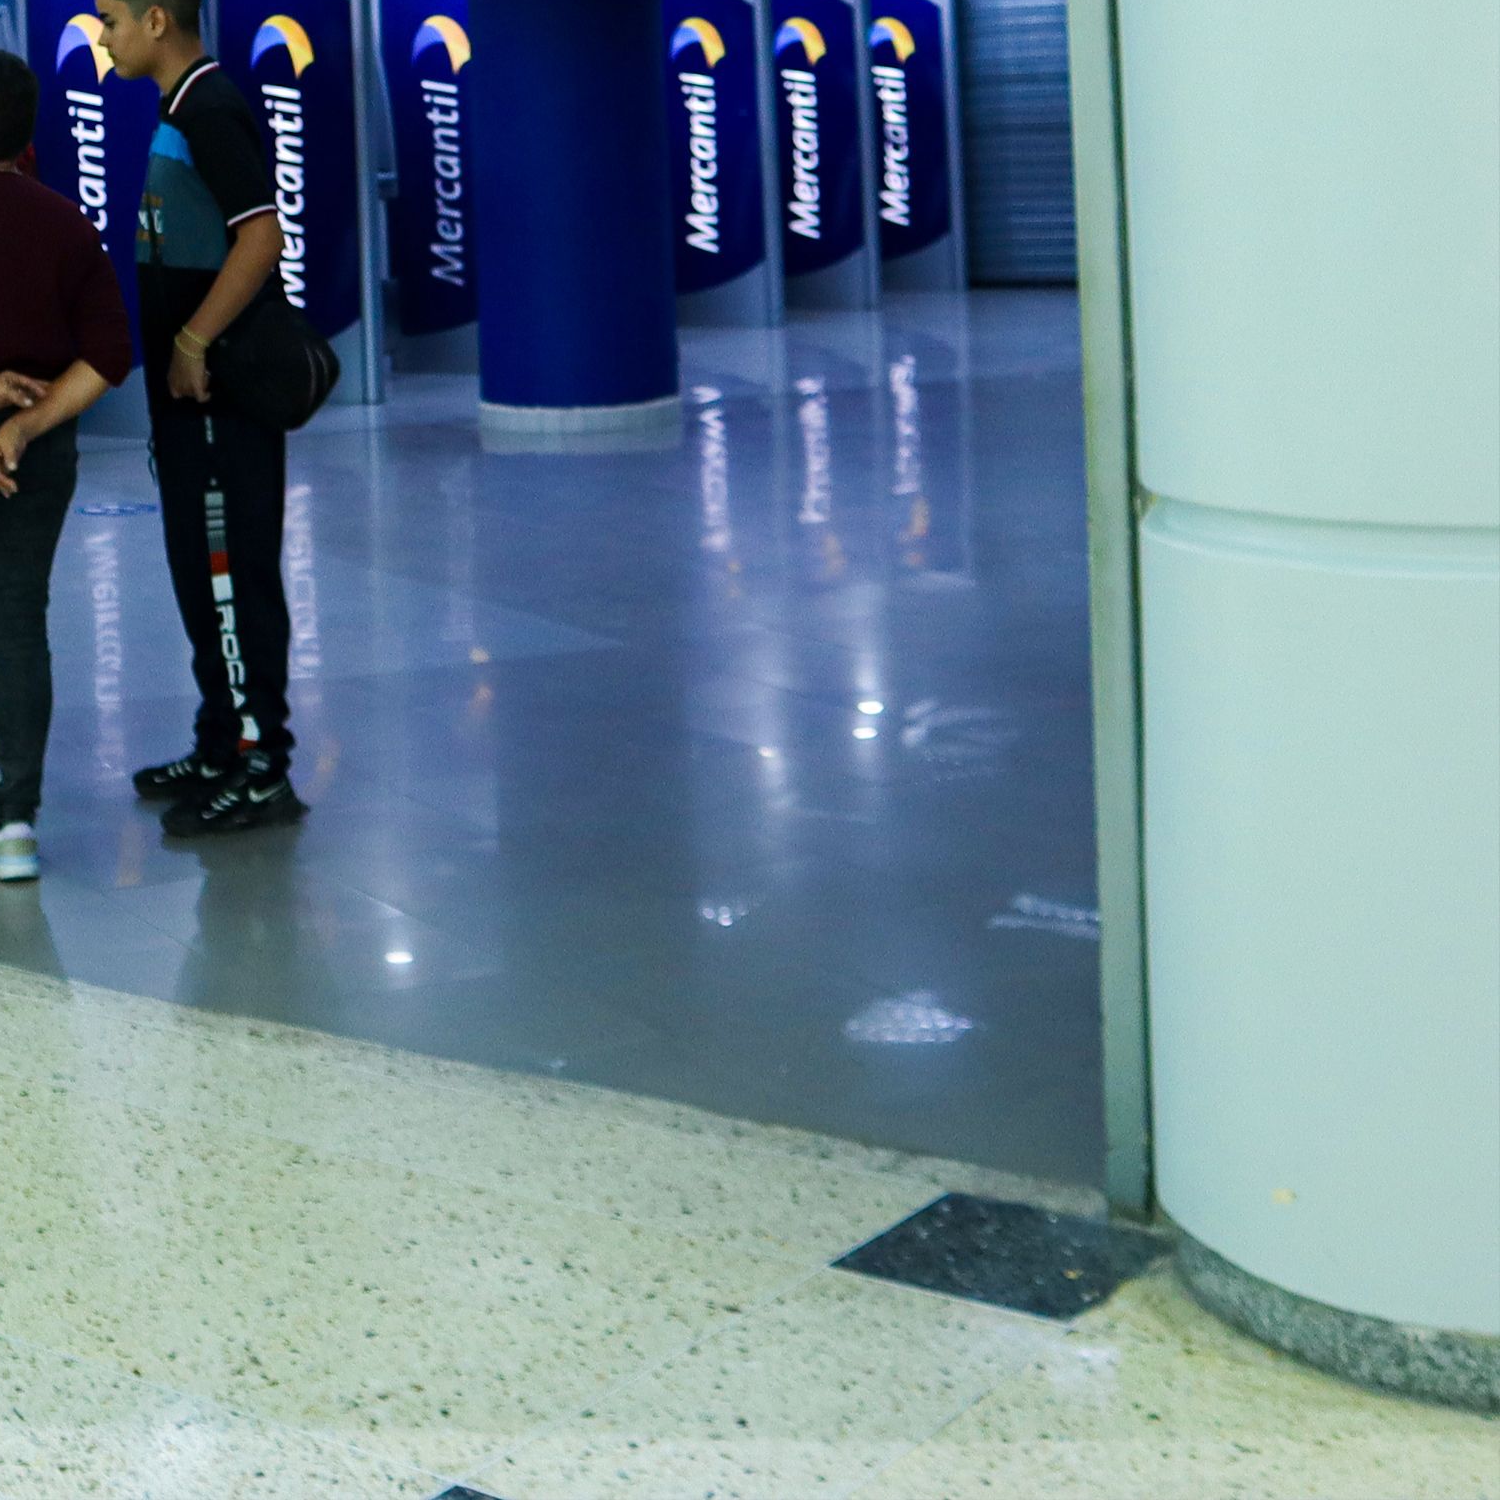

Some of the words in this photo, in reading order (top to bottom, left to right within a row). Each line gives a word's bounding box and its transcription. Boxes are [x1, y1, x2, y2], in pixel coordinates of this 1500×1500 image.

[261, 84, 306, 309] Mercantil
[420, 78, 467, 288] Mercantil
[678, 72, 719, 254] Mercantil
[781, 69, 820, 239] Mercantil
[871, 66, 910, 227] Mercantil
